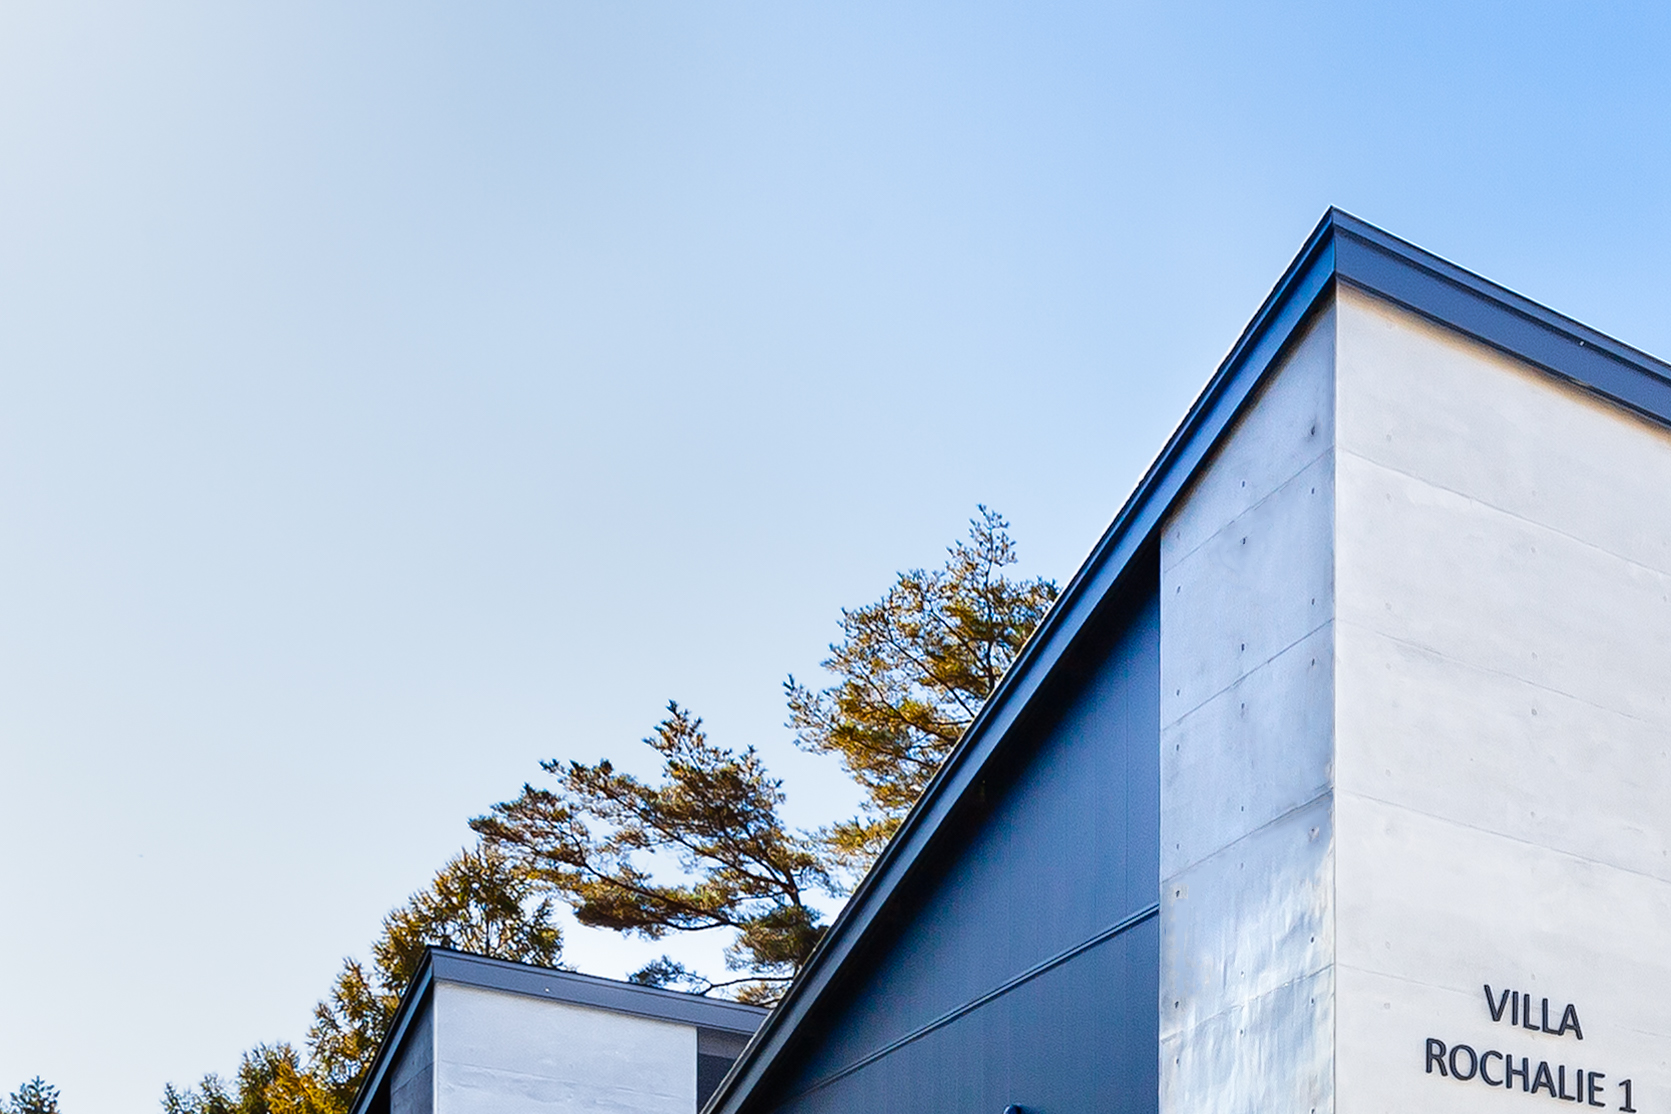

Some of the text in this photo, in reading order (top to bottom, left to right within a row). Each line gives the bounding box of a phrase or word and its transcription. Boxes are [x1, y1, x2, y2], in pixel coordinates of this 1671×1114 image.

[1483, 984, 1584, 1040] VILLA
[1425, 1037, 1637, 1114] ROCHALIE 1
